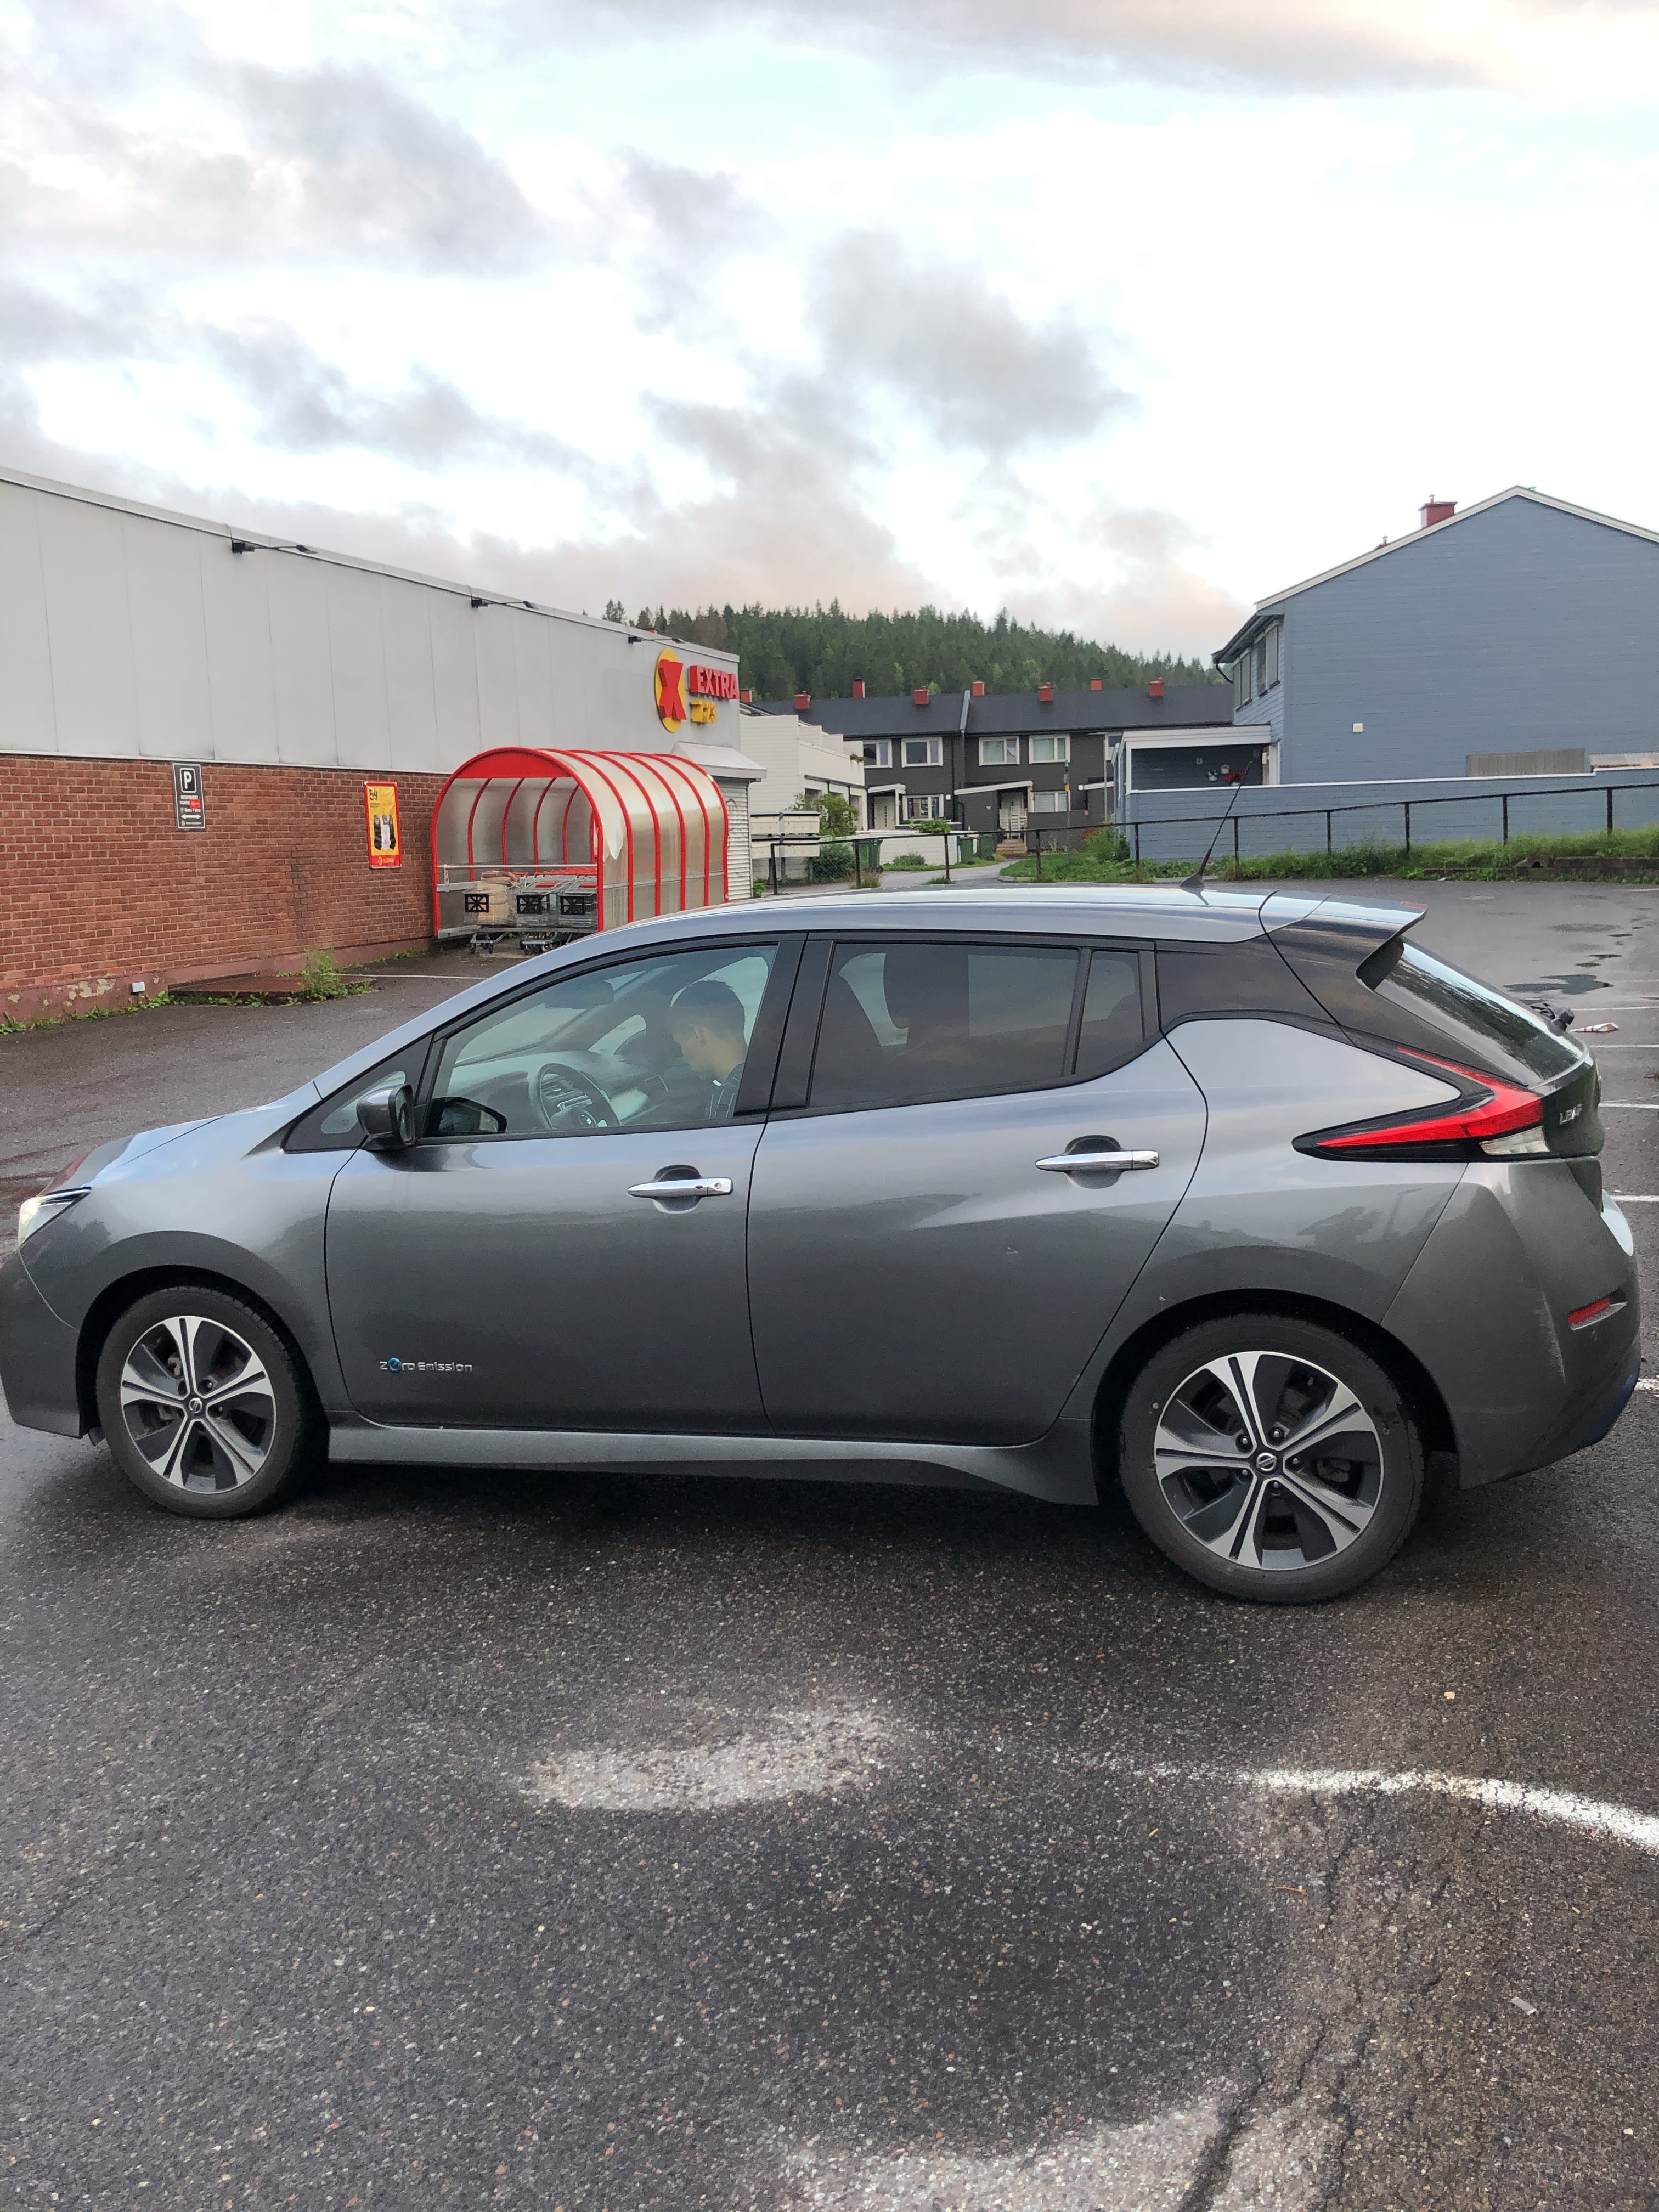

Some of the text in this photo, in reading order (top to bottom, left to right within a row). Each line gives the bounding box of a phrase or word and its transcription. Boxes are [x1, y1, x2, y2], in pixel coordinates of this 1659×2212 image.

[690, 665, 740, 699] EXTRA
[183, 771, 192, 789] P
[369, 789, 378, 801] 59
[417, 1362, 472, 1372] Emission
